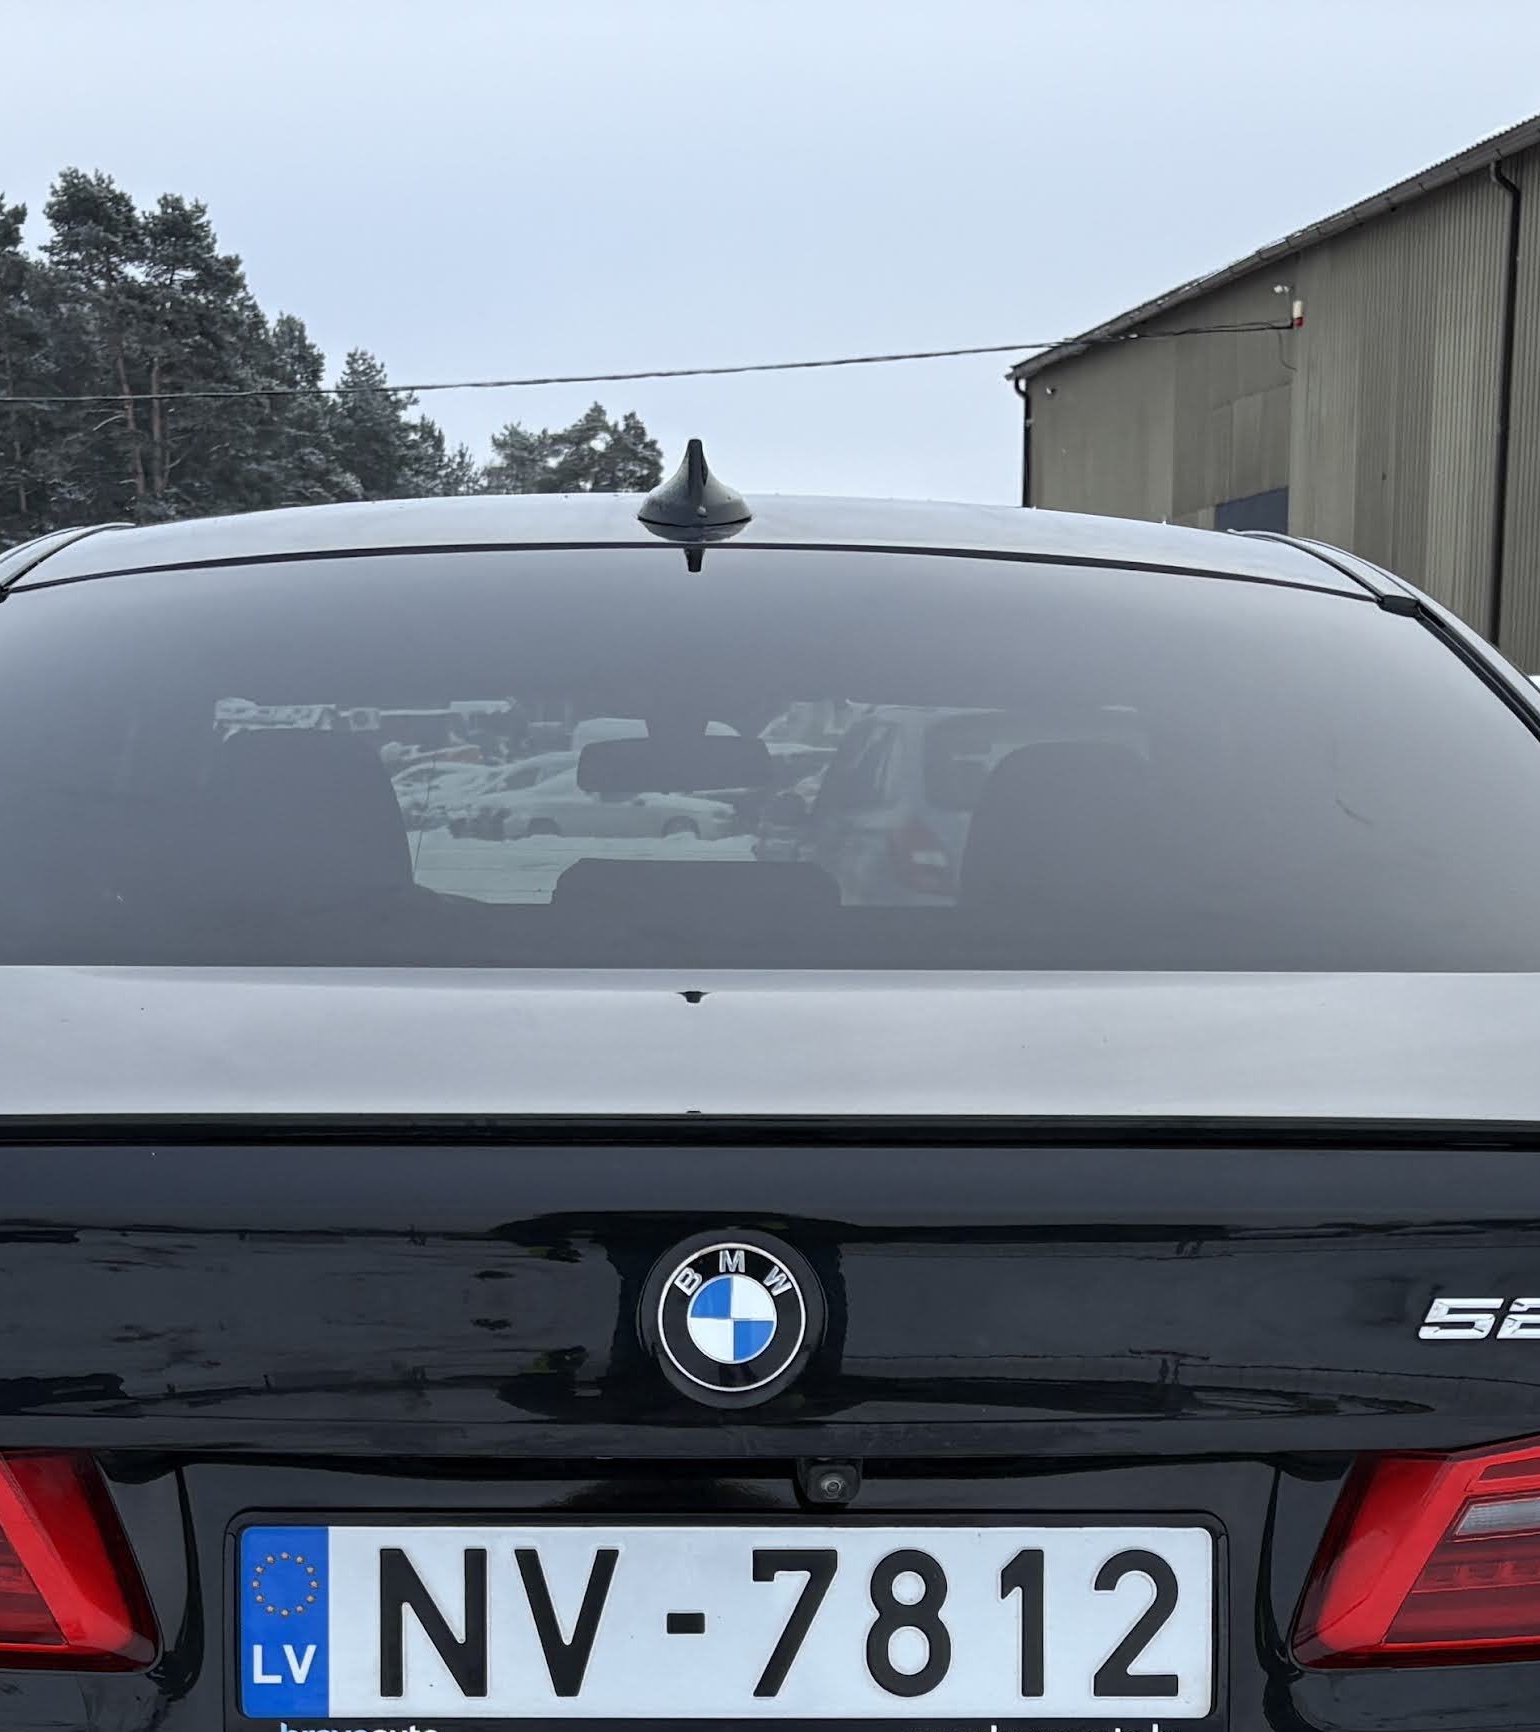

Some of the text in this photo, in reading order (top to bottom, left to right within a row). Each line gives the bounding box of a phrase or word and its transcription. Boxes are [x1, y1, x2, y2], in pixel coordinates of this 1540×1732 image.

[673, 1249, 793, 1297] BMW
[378, 1546, 1180, 1699] NV-7812
[252, 1644, 318, 1685] LV
